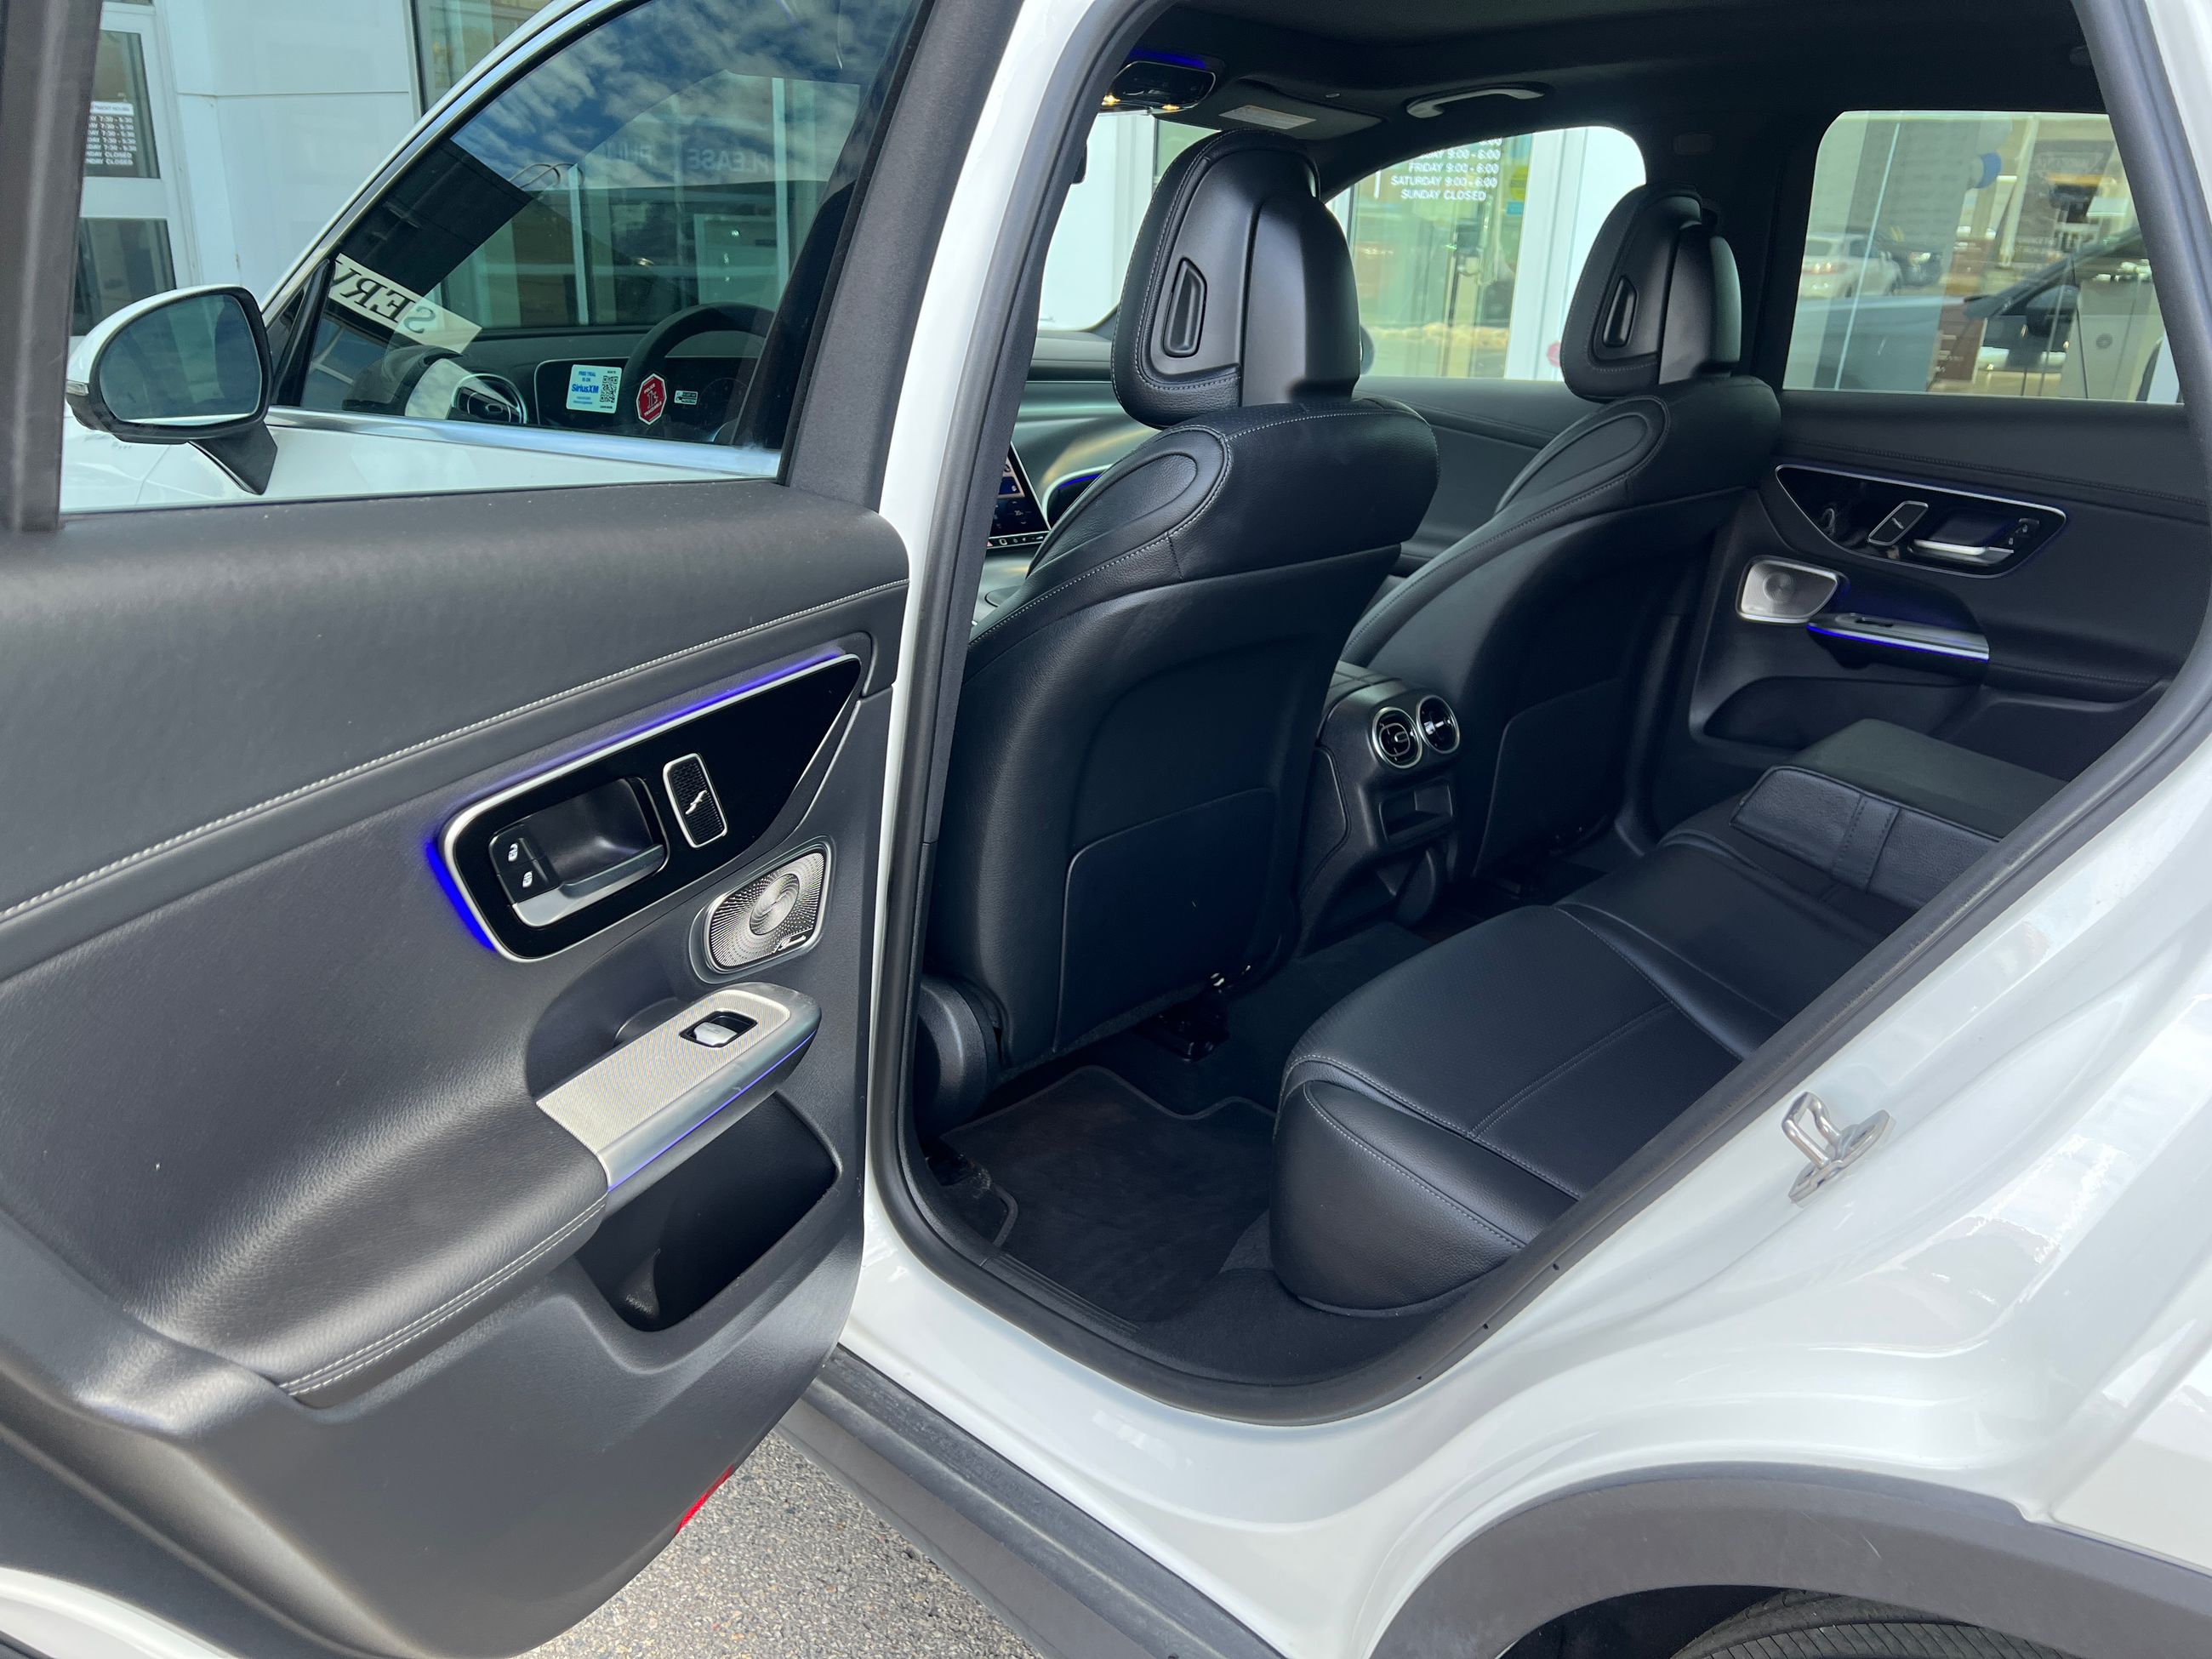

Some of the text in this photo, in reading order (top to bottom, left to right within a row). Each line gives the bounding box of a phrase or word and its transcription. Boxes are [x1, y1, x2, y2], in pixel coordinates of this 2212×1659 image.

[1447, 149, 1470, 159] 9:00
[1408, 162, 1444, 172] FRIDAY
[1445, 162, 1469, 173] 9:00
[1391, 175, 1443, 185] SATURDAY
[1445, 176, 1468, 186] 9:00
[1401, 189, 1486, 201] SUNDAY CLOSED
[572, 383, 599, 394] SiriusXM
